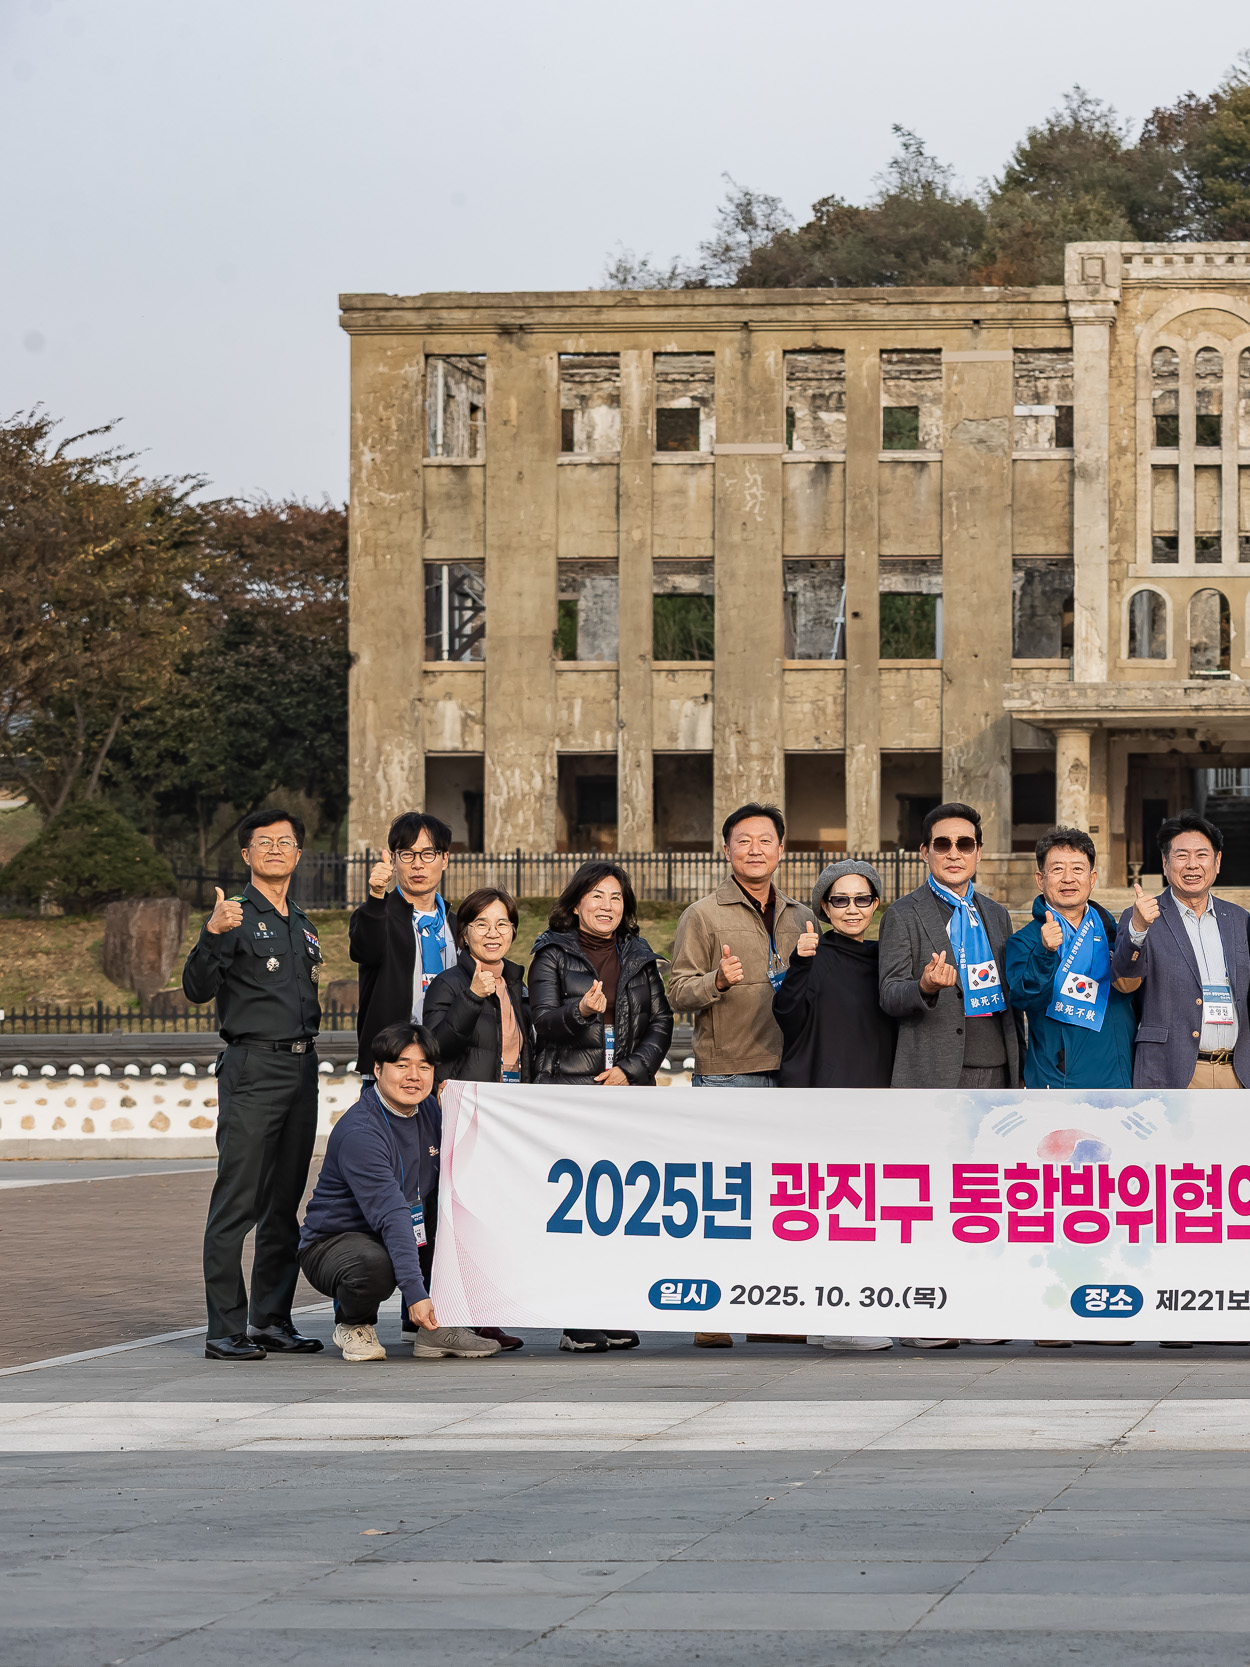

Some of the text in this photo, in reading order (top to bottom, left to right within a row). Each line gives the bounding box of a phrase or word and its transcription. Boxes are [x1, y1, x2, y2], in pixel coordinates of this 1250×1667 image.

[546, 1158, 752, 1240] 2025년
[769, 1162, 934, 1244] 광진구
[659, 1282, 709, 1305] 일시
[729, 1284, 948, 1310] 2025. 10. 30.(목)
[1084, 1288, 1133, 1312] 장소
